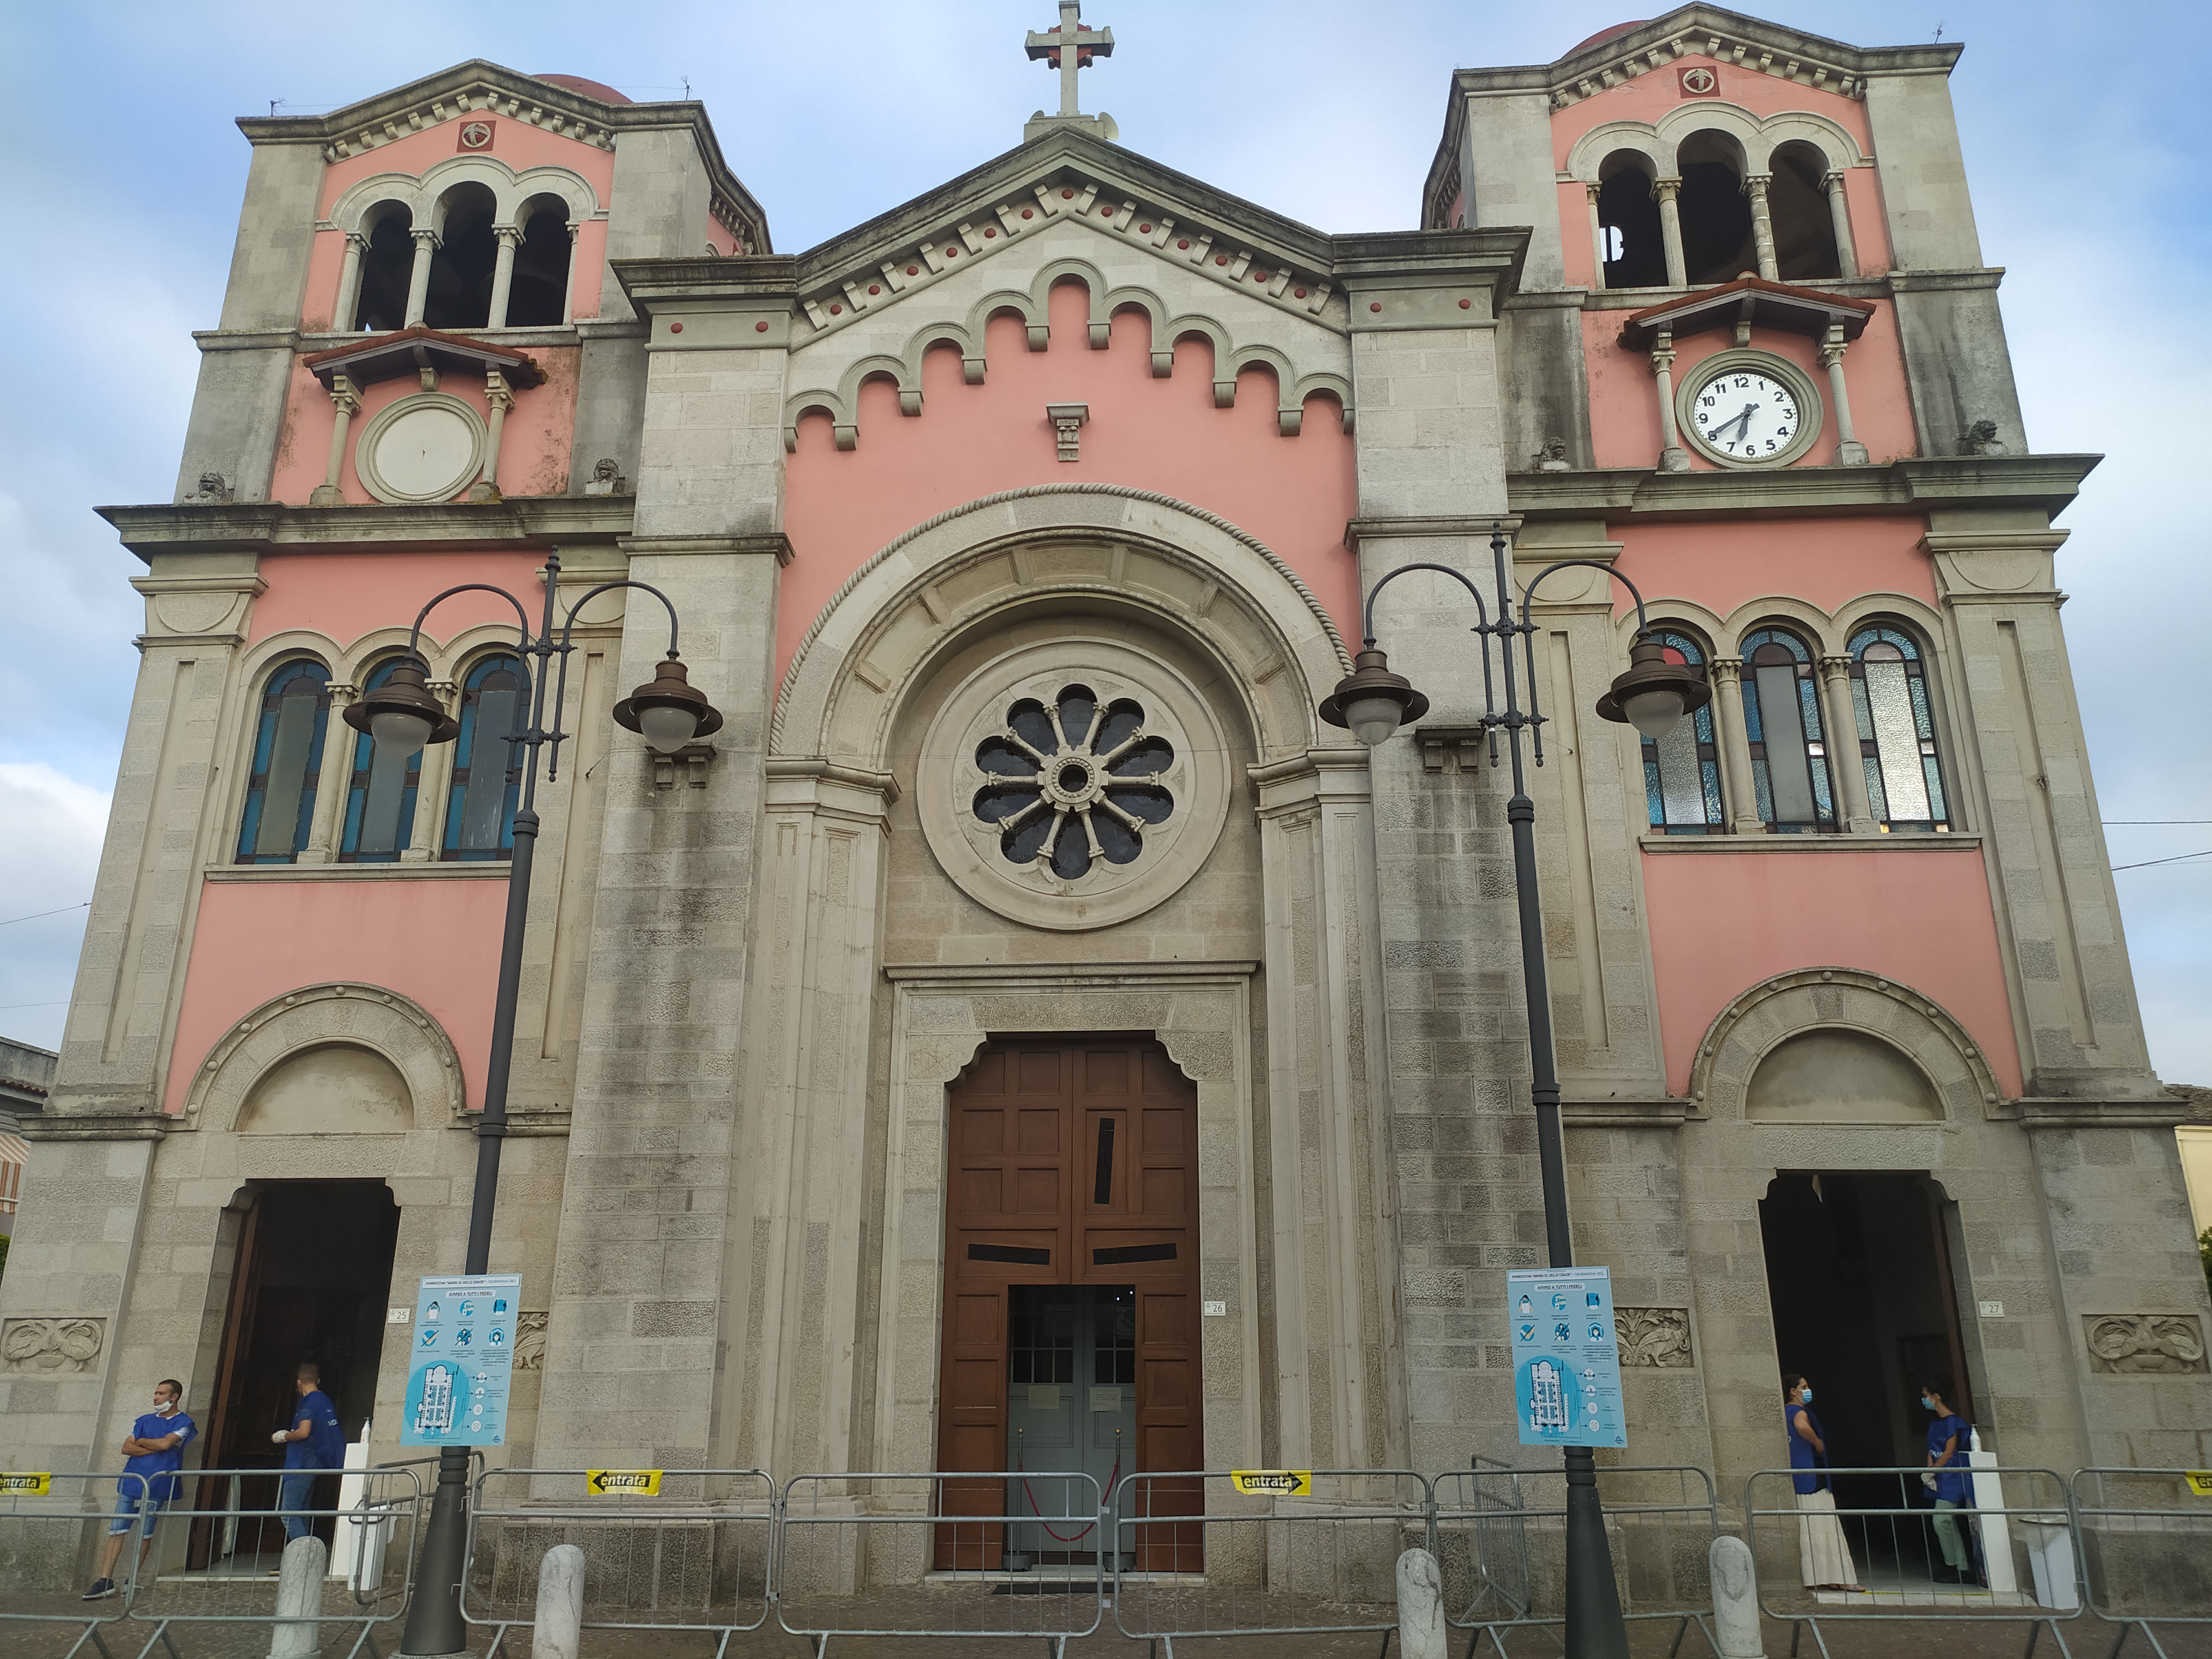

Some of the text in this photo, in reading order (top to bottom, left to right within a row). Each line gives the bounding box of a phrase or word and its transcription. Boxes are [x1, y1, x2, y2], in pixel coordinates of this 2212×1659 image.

[1733, 377, 1749, 388] 12
[1758, 380, 1764, 391] 1
[1715, 384, 1726, 394] 11
[1702, 396, 1715, 406] 10
[1773, 392, 1784, 402] 2
[1698, 413, 1708, 424] 9
[1782, 408, 1793, 419] 3
[1708, 430, 1717, 441] 8
[1777, 426, 1789, 437] 4
[1726, 442, 1736, 452] 7
[1746, 445, 1756, 456] 6
[1766, 440, 1776, 450] 5
[1989, 1305, 1999, 1313] 27
[601, 1475, 646, 1486] entrata
[1244, 1476, 1292, 1487] entrata
